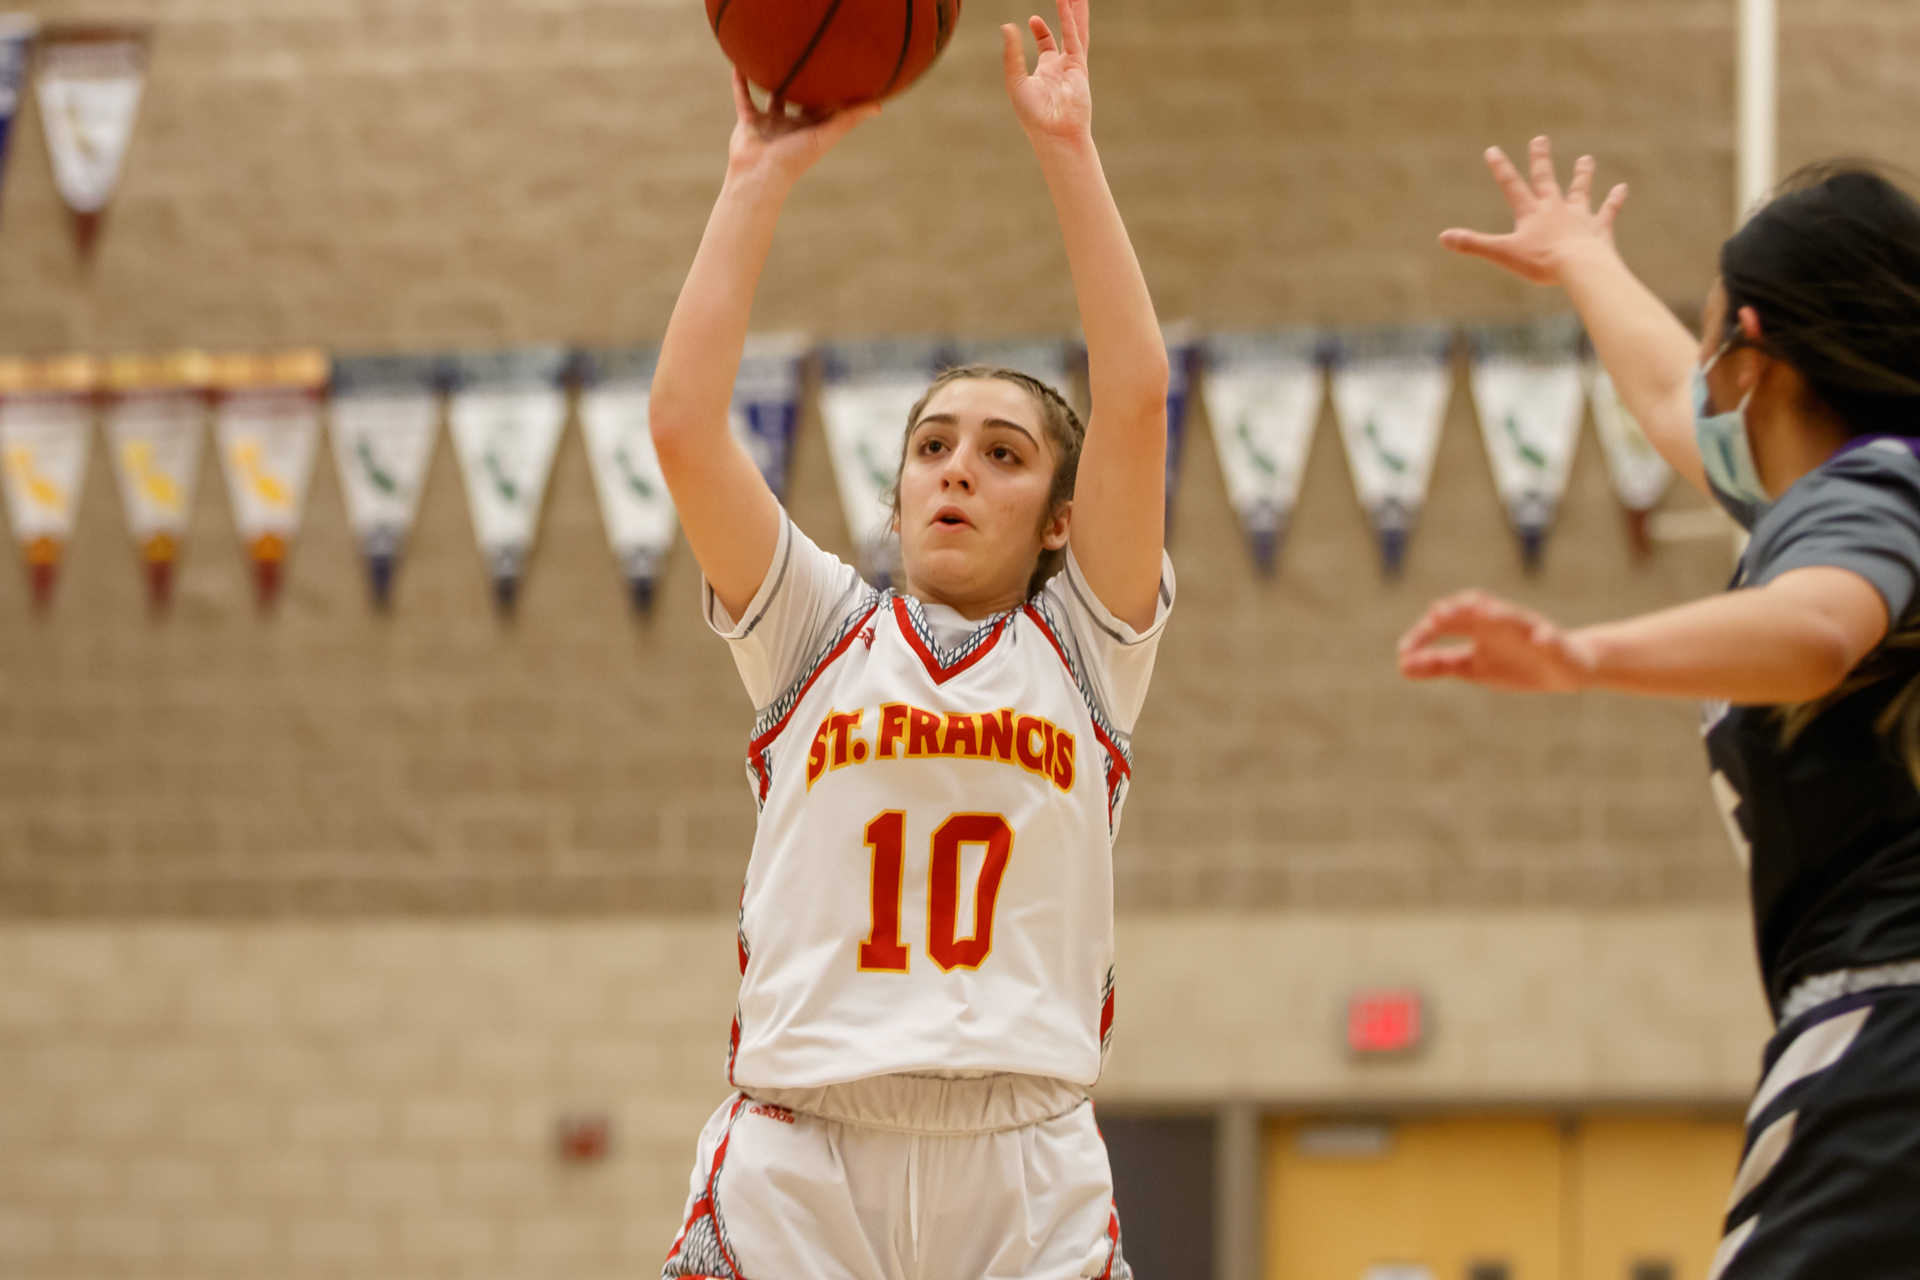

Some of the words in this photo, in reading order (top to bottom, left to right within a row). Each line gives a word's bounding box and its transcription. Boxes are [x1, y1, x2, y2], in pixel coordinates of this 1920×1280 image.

[806, 706, 869, 793] ST.
[875, 702, 1076, 794] FRANCIS
[857, 808, 1016, 975] 10
